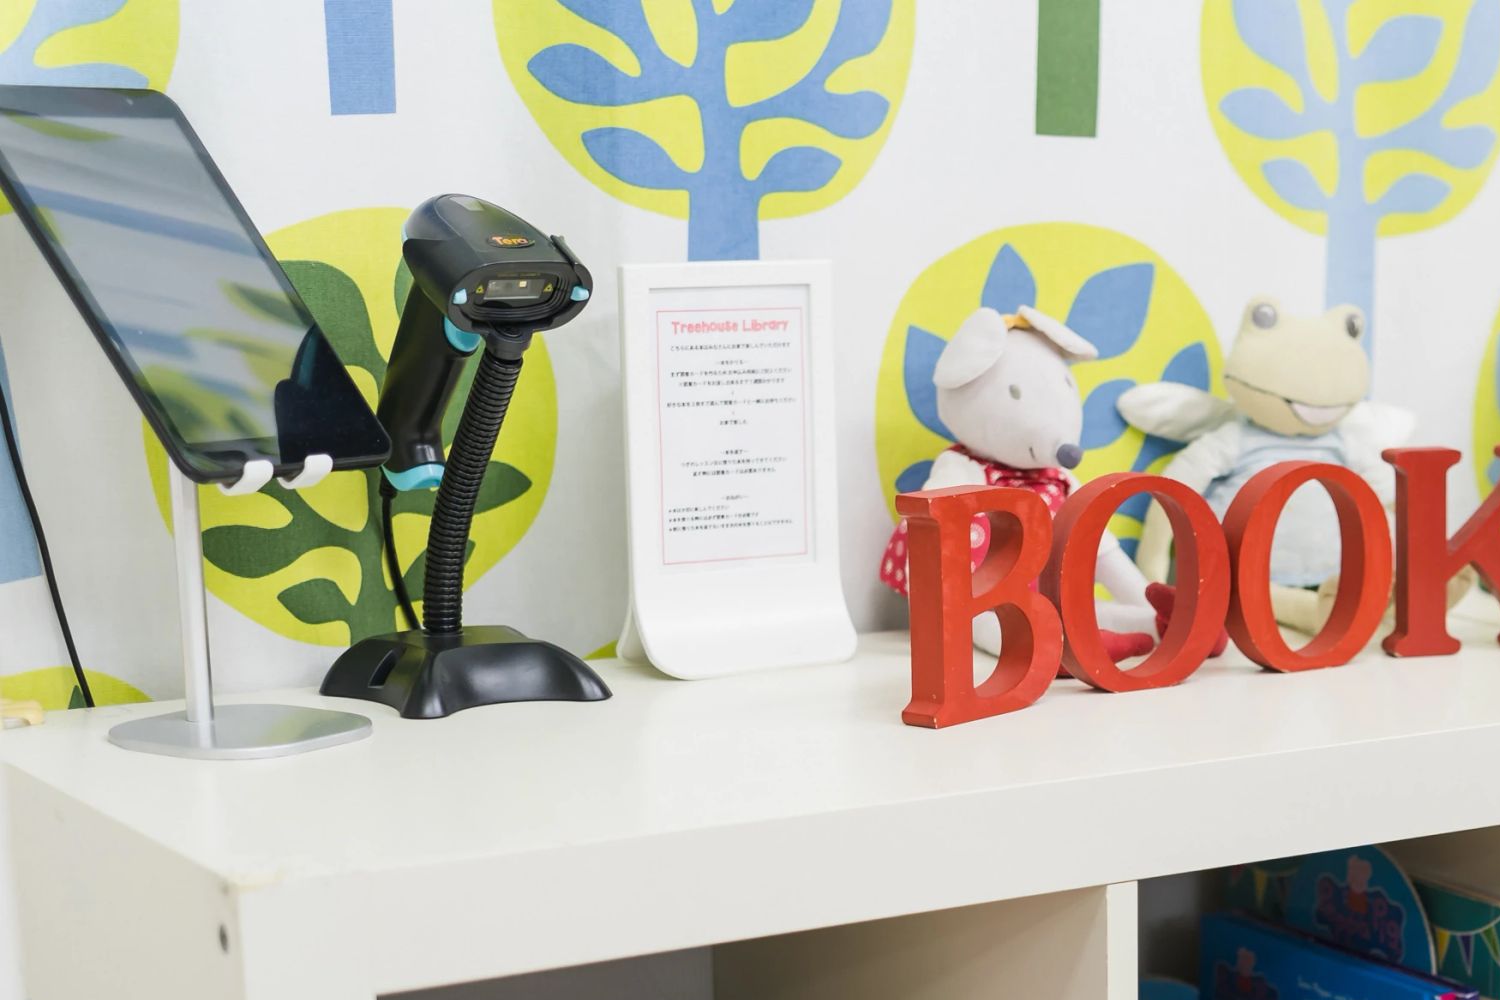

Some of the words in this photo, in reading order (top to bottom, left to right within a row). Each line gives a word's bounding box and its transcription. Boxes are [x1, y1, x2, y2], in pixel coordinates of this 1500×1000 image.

[492, 236, 528, 246] Tera
[671, 319, 738, 336] Treehouse
[742, 318, 789, 332] Library
